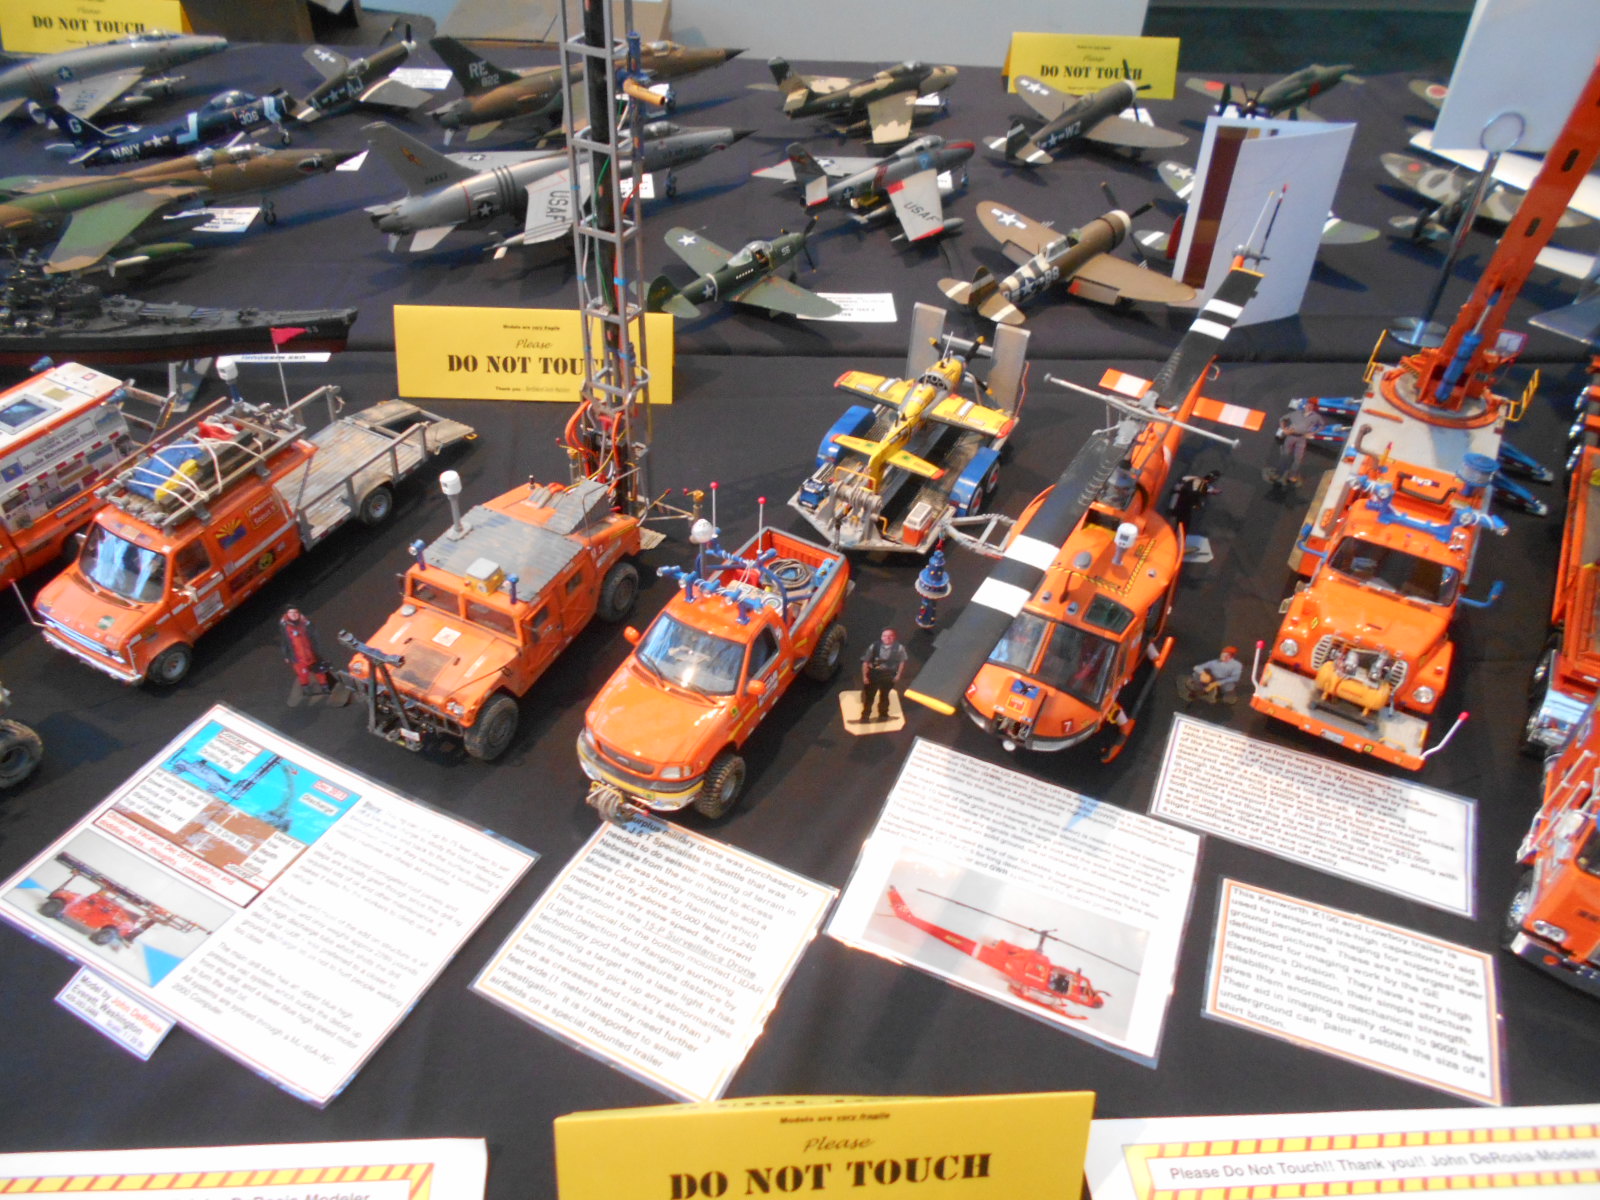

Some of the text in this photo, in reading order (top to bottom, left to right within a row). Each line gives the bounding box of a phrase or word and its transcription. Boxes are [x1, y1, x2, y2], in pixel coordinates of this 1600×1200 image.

[32, 15, 145, 34] DO NOT TOUCH
[1041, 65, 1059, 76] DO
[1064, 66, 1091, 78] NOT
[111, 144, 141, 158] NAVY
[545, 190, 570, 223] USAF
[904, 202, 940, 223] USAF
[516, 338, 552, 350] Please
[448, 355, 478, 372] DO
[486, 356, 532, 374] NOT
[1064, 721, 1072, 732] 7
[632, 817, 661, 832] urplus
[662, 829, 695, 848] military
[696, 844, 723, 859] drone
[725, 857, 743, 868] was
[744, 866, 794, 890] purchased
[606, 830, 639, 848] needed
[664, 856, 698, 874] seismic
[700, 872, 740, 894] mapping
[754, 894, 784, 911] terrain
[652, 837, 700, 862] Specialists
[714, 863, 744, 881] Seattle
[746, 878, 765, 889] that
[767, 888, 786, 899] was
[780, 1116, 813, 1124] Models
[858, 1112, 890, 1122] fragile
[803, 1137, 875, 1152] Please
[1169, 1167, 1220, 1180] Please
[1223, 1165, 1244, 1178] Do
[1248, 1164, 1276, 1176] Not
[1279, 1160, 1335, 1176] Touch!!
[1339, 1157, 1384, 1172] Thank
[1390, 1155, 1426, 1173] you!!
[1430, 1154, 1468, 1168] John
[670, 1154, 992, 1200] DO NOT TOUCH
